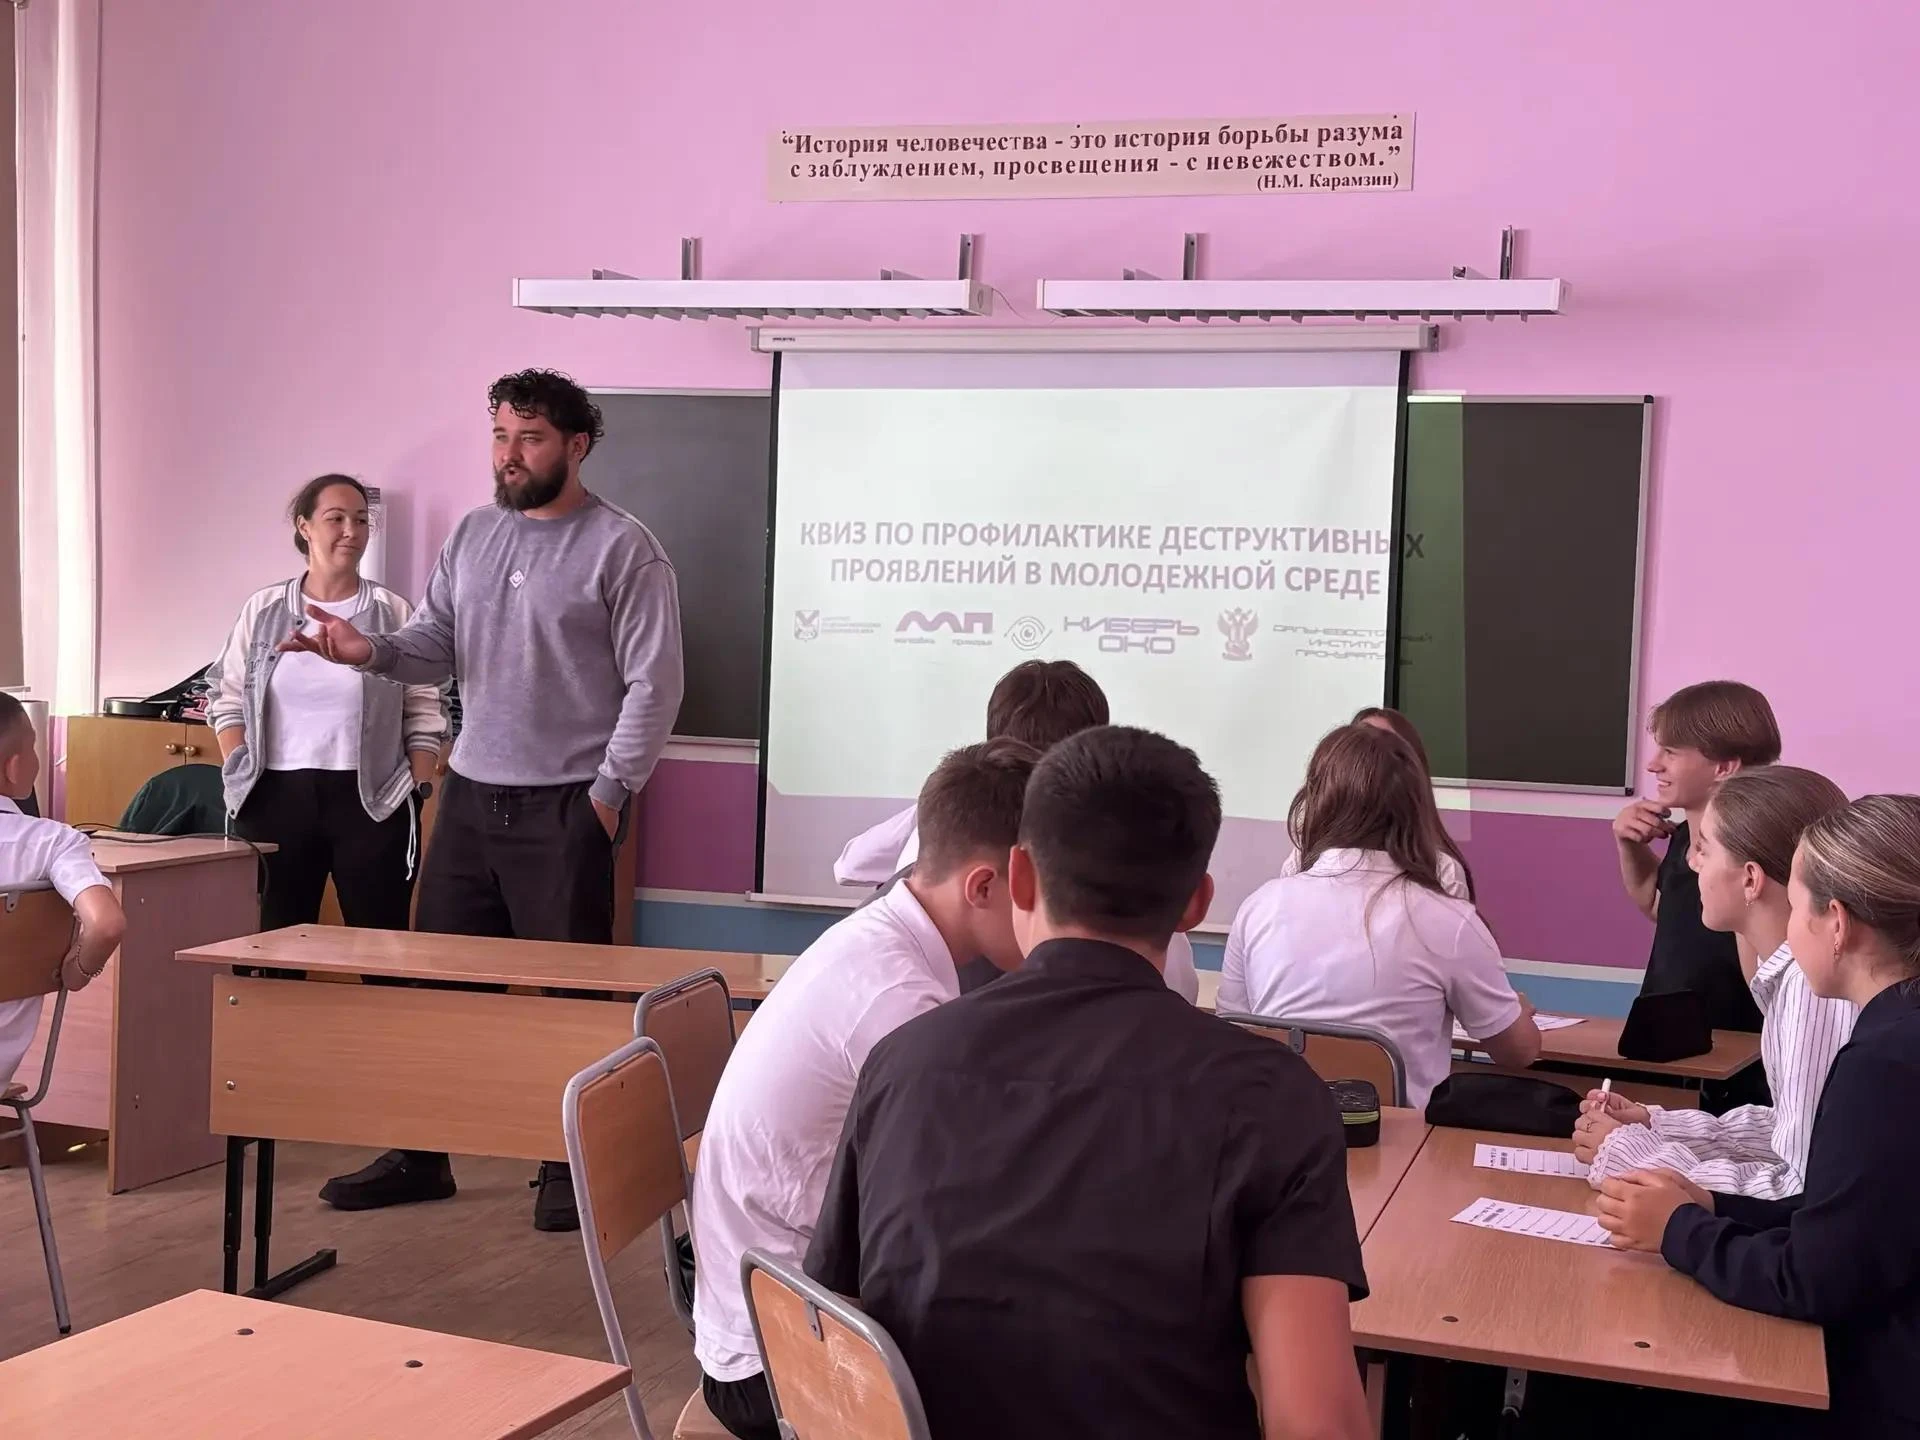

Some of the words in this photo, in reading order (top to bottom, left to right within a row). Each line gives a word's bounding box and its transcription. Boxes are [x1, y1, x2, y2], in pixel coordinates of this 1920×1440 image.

[896, 134, 1047, 152] человечества
[1070, 135, 1106, 150] это
[1114, 131, 1209, 151] история
[1218, 125, 1308, 150] борьбы
[1317, 124, 1403, 146] разума
[790, 164, 800, 178] с
[808, 159, 984, 182] заблуждением,
[993, 157, 1159, 180] просвещения
[1186, 156, 1197, 171] с
[1256, 174, 1303, 192] (Н.М.
[1310, 172, 1399, 191] Карамзин)
[800, 521, 867, 546] КВИЗ
[875, 522, 914, 546] ПО
[922, 522, 1152, 549] ПРОФИЛАКТИКЕ
[831, 555, 1017, 585] ПРОЯВЛЕНИЙ
[1025, 562, 1042, 585] В
[1050, 560, 1275, 594] МОЛОДЕЖНОЙ
[1285, 567, 1381, 600] СРЕДЕ
[1098, 634, 1175, 654] ОКО
